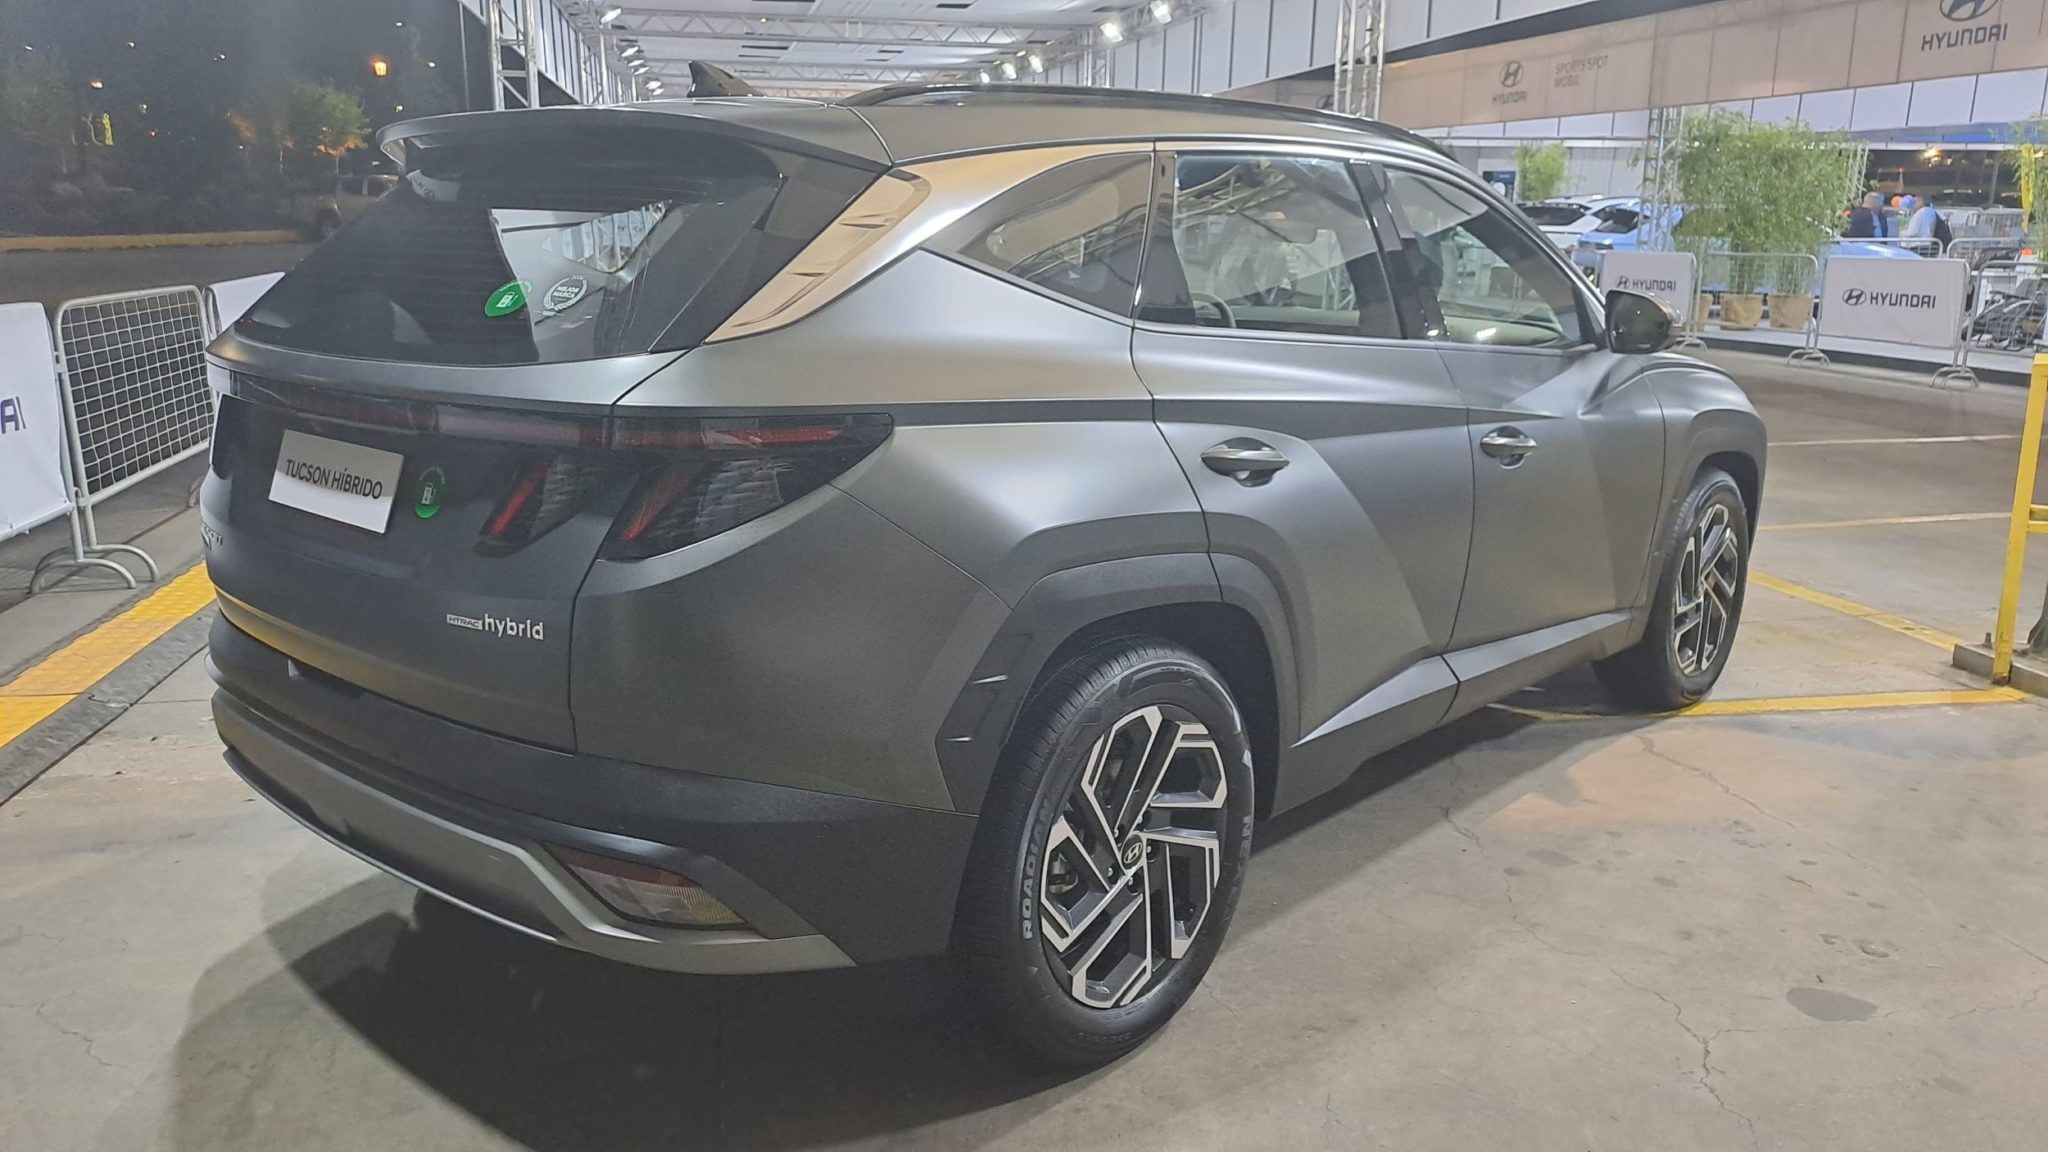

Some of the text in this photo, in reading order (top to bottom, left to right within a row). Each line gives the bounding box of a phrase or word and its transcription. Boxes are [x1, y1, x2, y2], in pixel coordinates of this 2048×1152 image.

[1921, 23, 2008, 51] HYUNDAI
[1491, 91, 1528, 104] HYUNDAI
[1632, 279, 1677, 292] HYUNDAI
[1869, 291, 1937, 309] HYUNDAI
[286, 458, 330, 487] TUCSON
[331, 467, 383, 500] HÍBRIDO
[484, 613, 544, 640] hybrid
